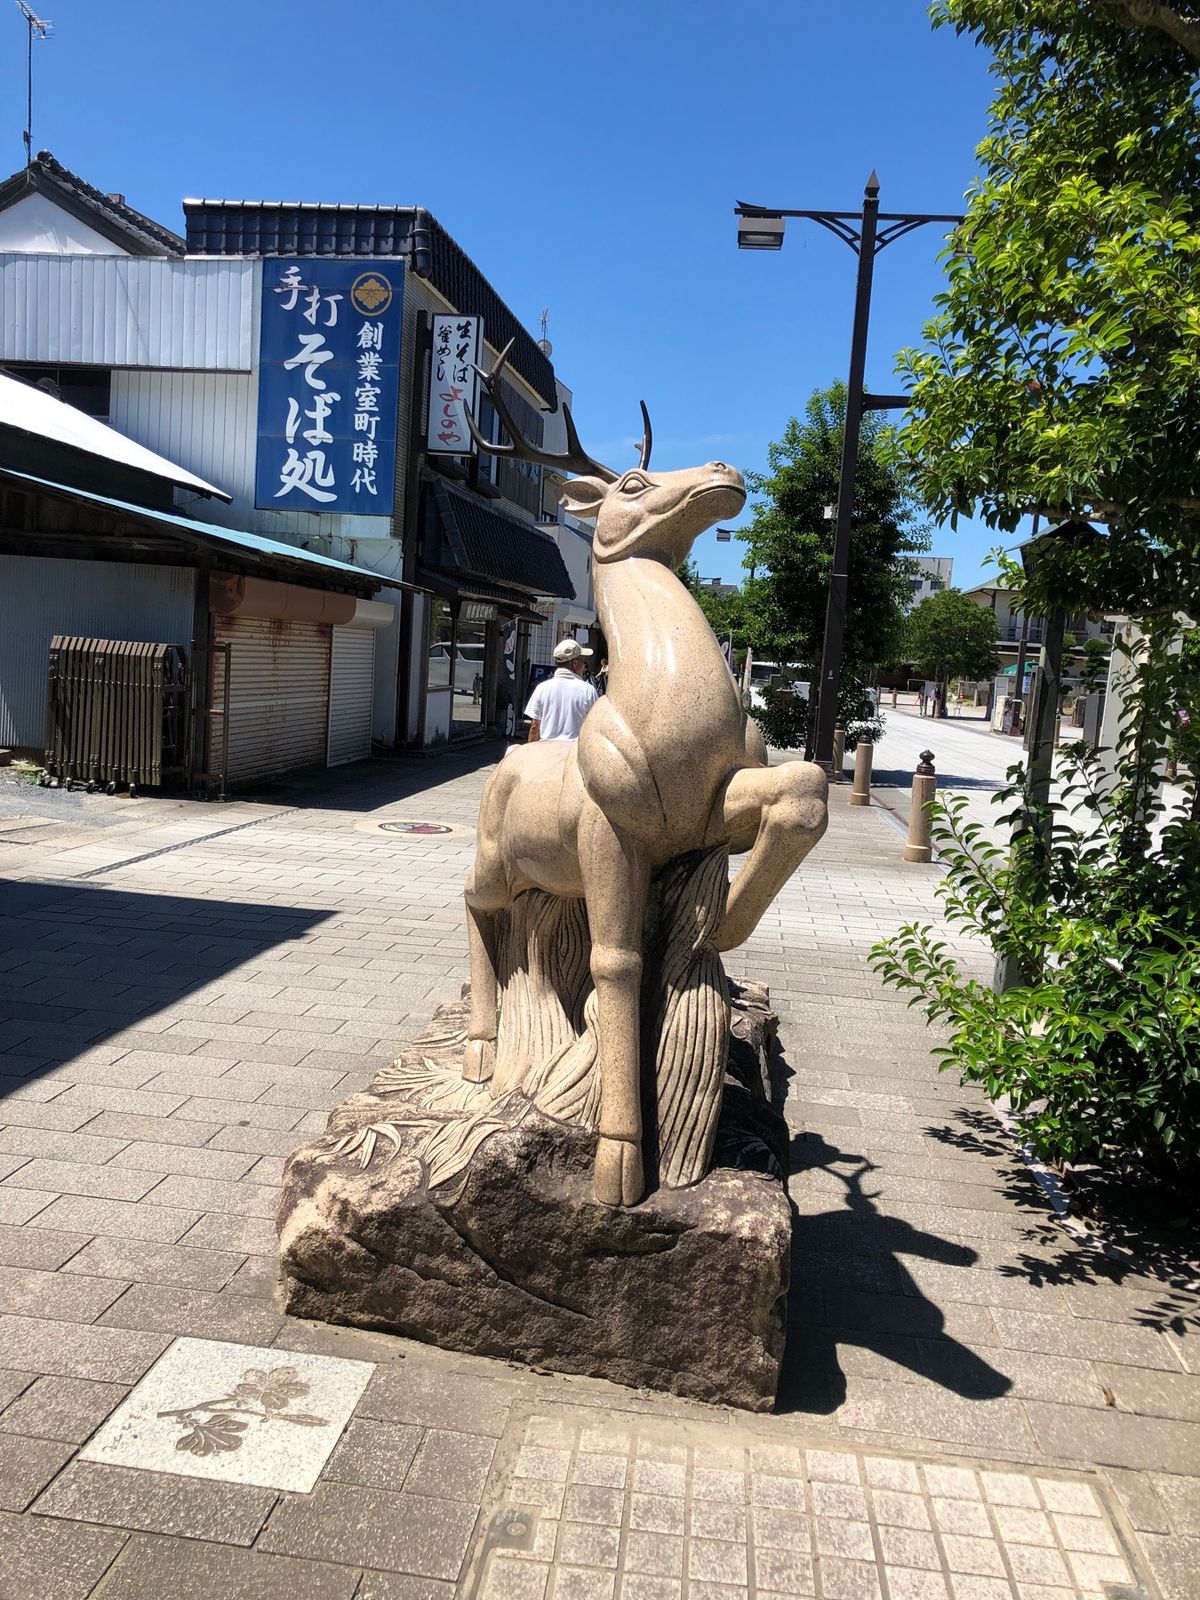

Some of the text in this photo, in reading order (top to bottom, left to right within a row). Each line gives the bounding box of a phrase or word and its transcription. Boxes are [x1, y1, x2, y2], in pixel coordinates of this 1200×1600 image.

[453, 320, 472, 383] 生そば
[350, 321, 384, 496] 創業室町時代
[437, 385, 464, 445] よしのや
[535, 667, 544, 678] P
